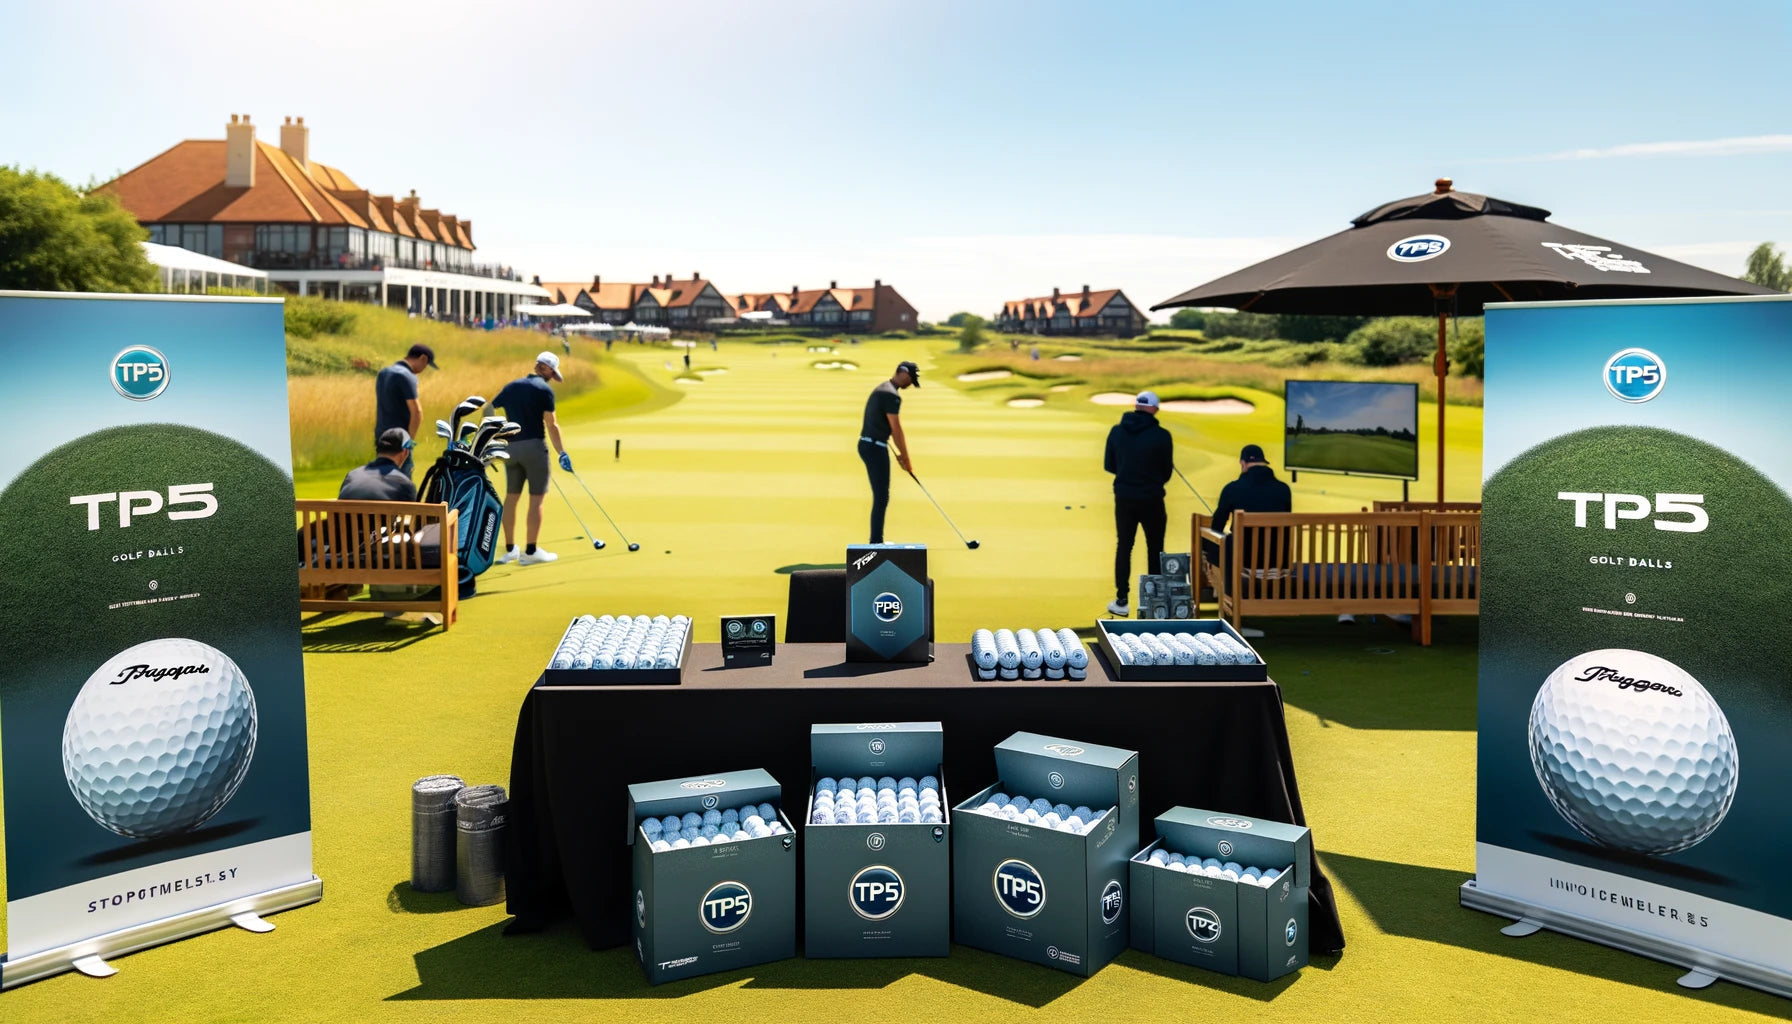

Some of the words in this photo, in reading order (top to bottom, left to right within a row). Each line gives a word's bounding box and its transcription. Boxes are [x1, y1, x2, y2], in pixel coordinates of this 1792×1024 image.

[117, 362, 164, 382] TP5
[1610, 365, 1660, 385] TP5
[69, 482, 219, 531] TP5
[1557, 491, 1710, 533] TP5
[112, 551, 143, 562] GOLF
[855, 882, 899, 902] TP5
[998, 872, 1041, 904] TP5
[705, 894, 749, 919] TP5
